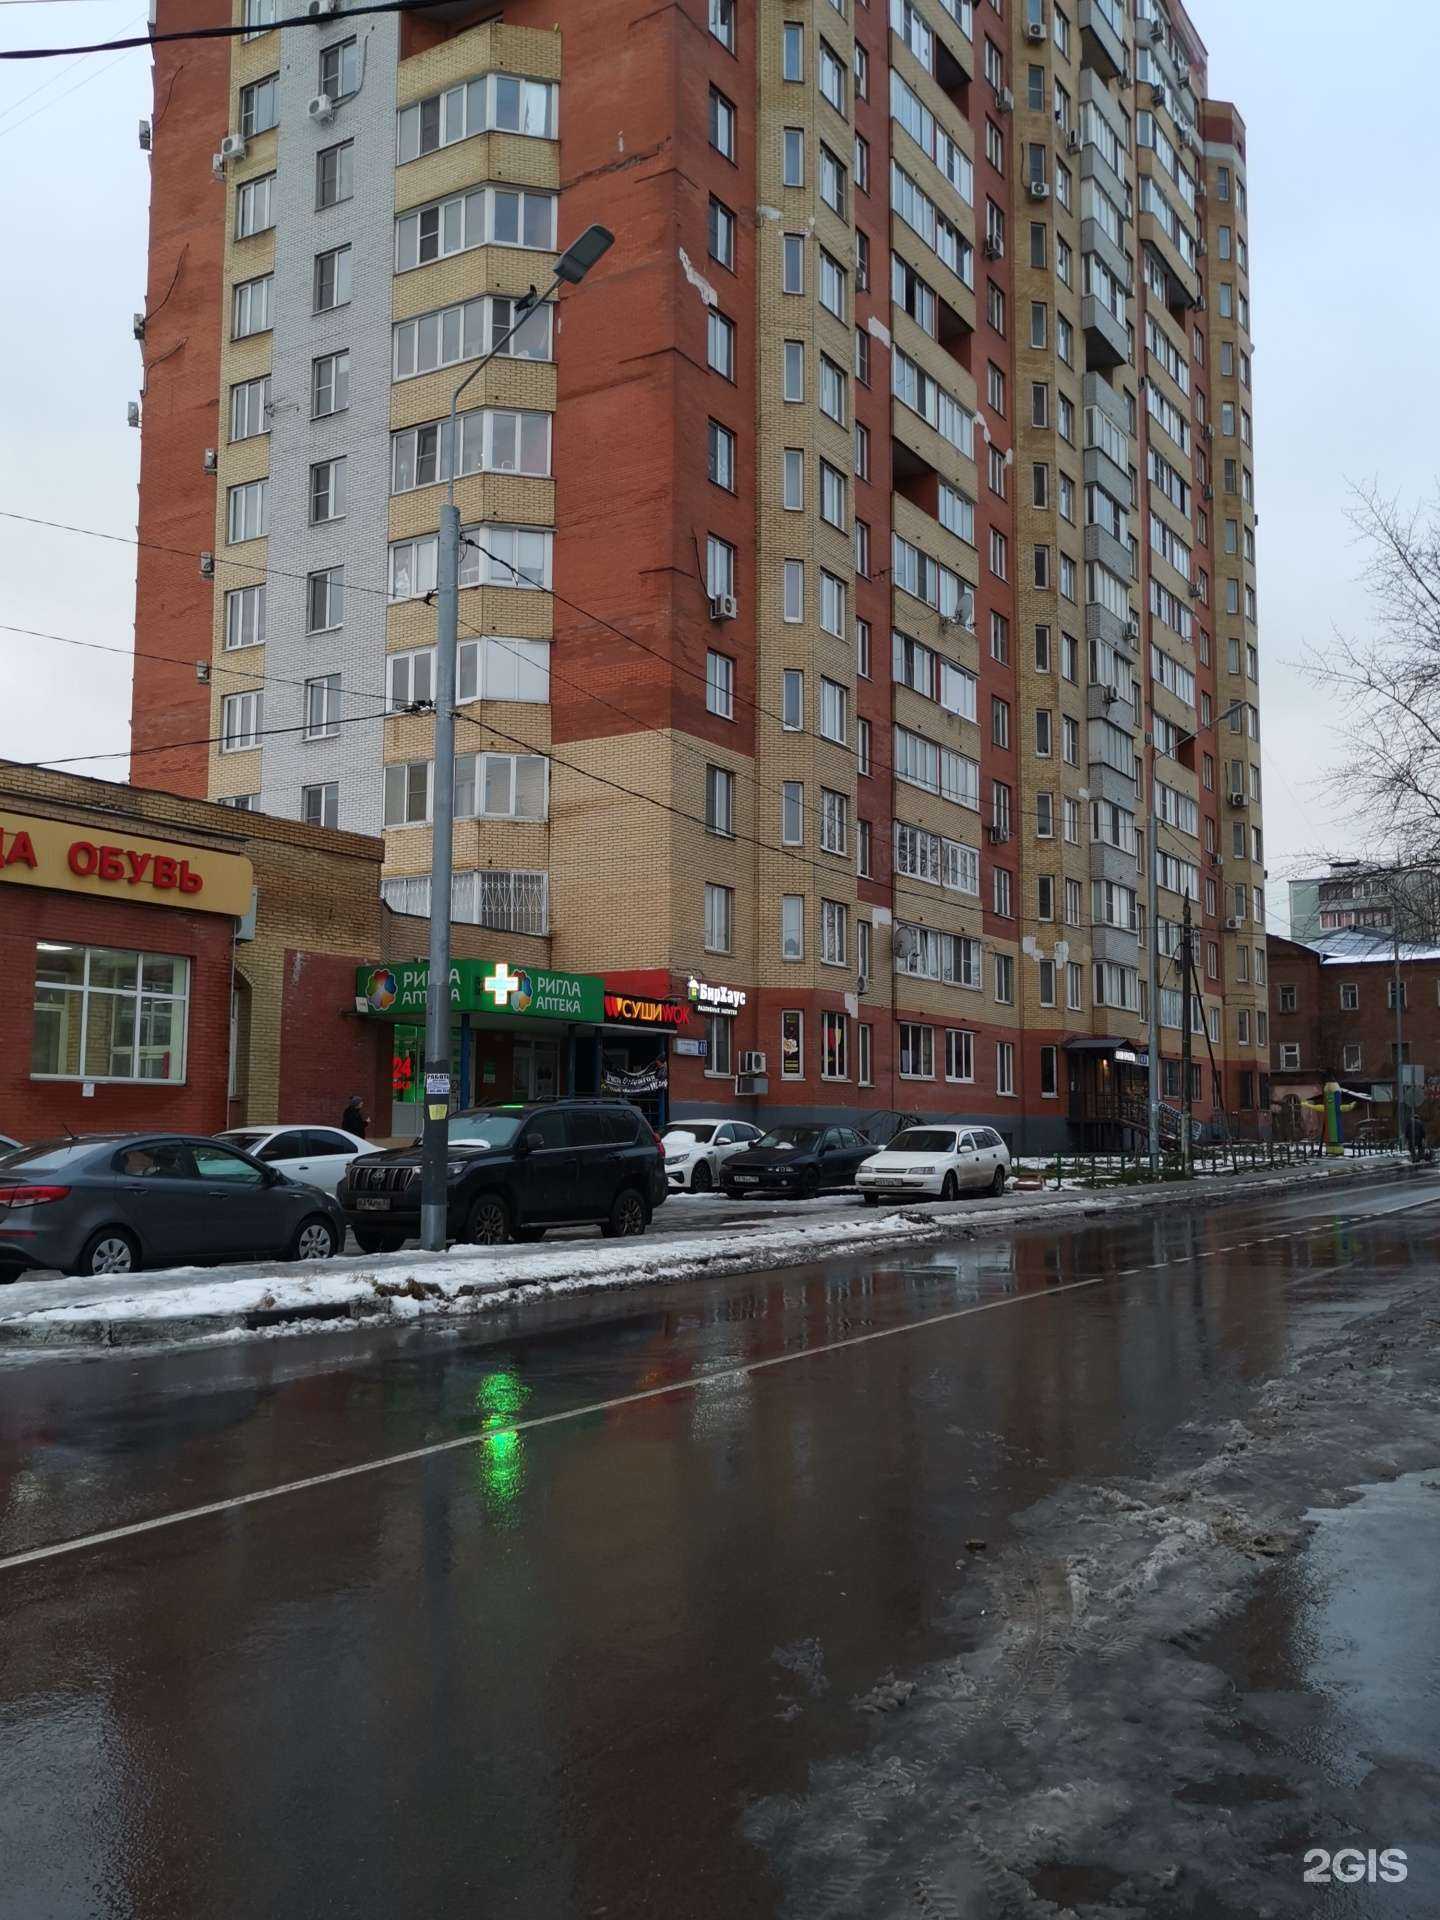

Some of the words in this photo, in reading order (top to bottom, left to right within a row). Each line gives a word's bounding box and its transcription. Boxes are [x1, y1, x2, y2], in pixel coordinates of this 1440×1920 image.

[68, 841, 203, 894] ОБУВЬ
[403, 968, 461, 987] РИА
[537, 976, 581, 998] РИГЛА
[401, 988, 461, 1005] АПТА
[536, 996, 582, 1014] АПТЕКА
[700, 984, 746, 1008] БирХаус
[392, 1056, 411, 1078] 24
